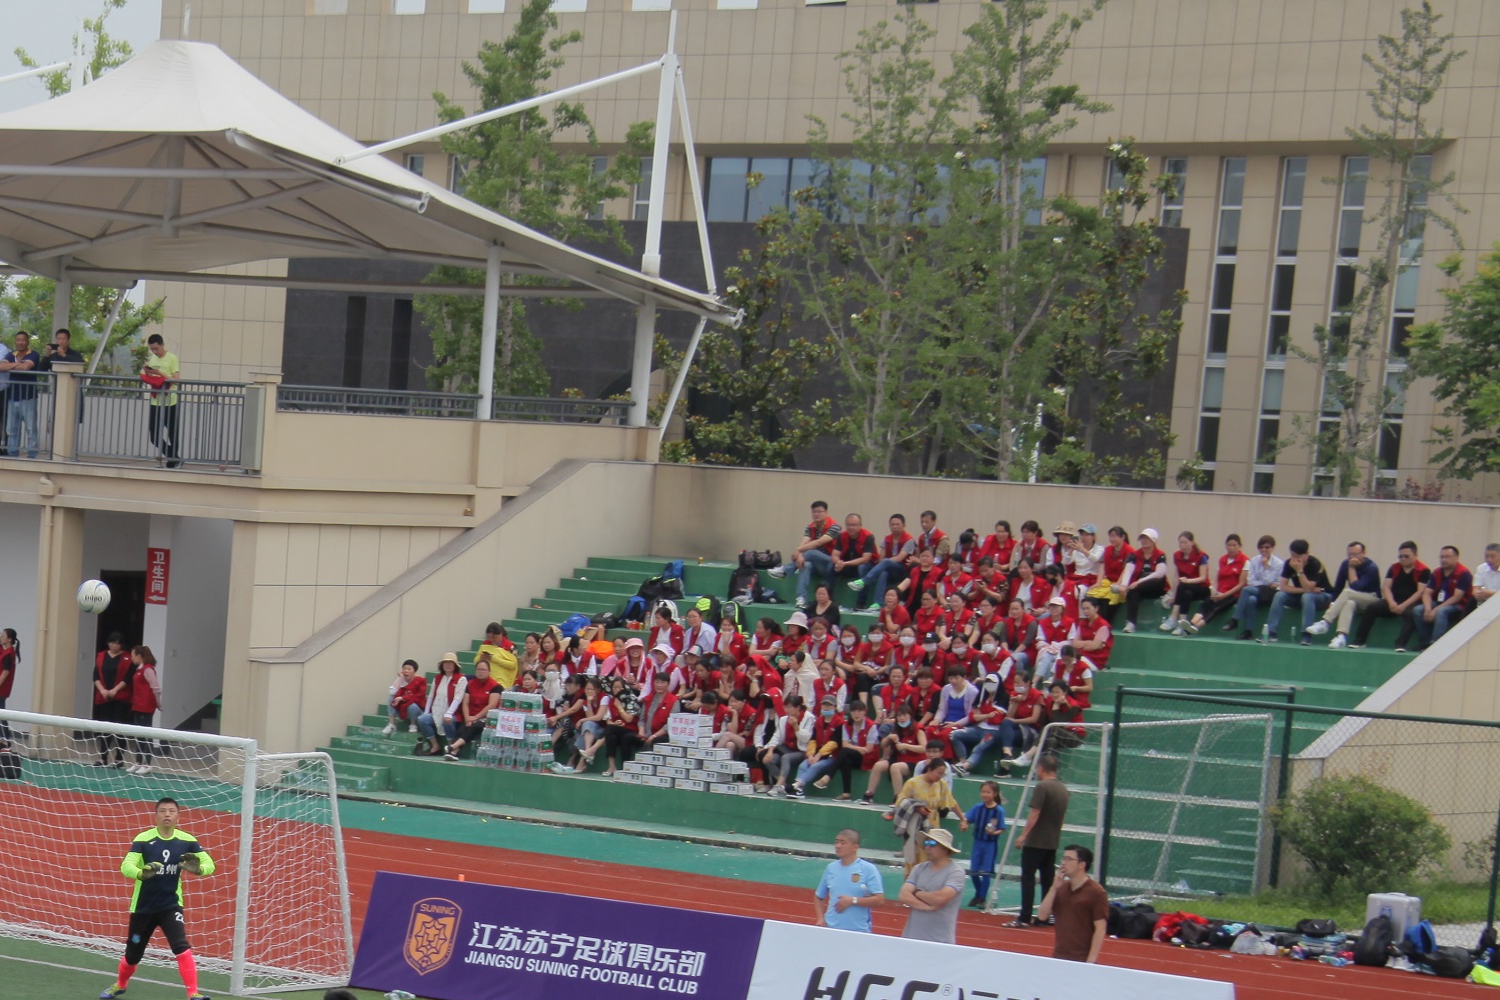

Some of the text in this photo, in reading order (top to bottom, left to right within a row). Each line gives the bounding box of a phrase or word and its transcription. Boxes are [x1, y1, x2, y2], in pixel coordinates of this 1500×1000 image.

[151, 551, 166, 594] 卫生间
[162, 849, 171, 862] 9
[420, 904, 456, 915] SUNING
[468, 922, 706, 977] 江苏苏宁足球俱乐部
[464, 951, 698, 994] JIANGSU SUNING FOOTBALL CLUB
